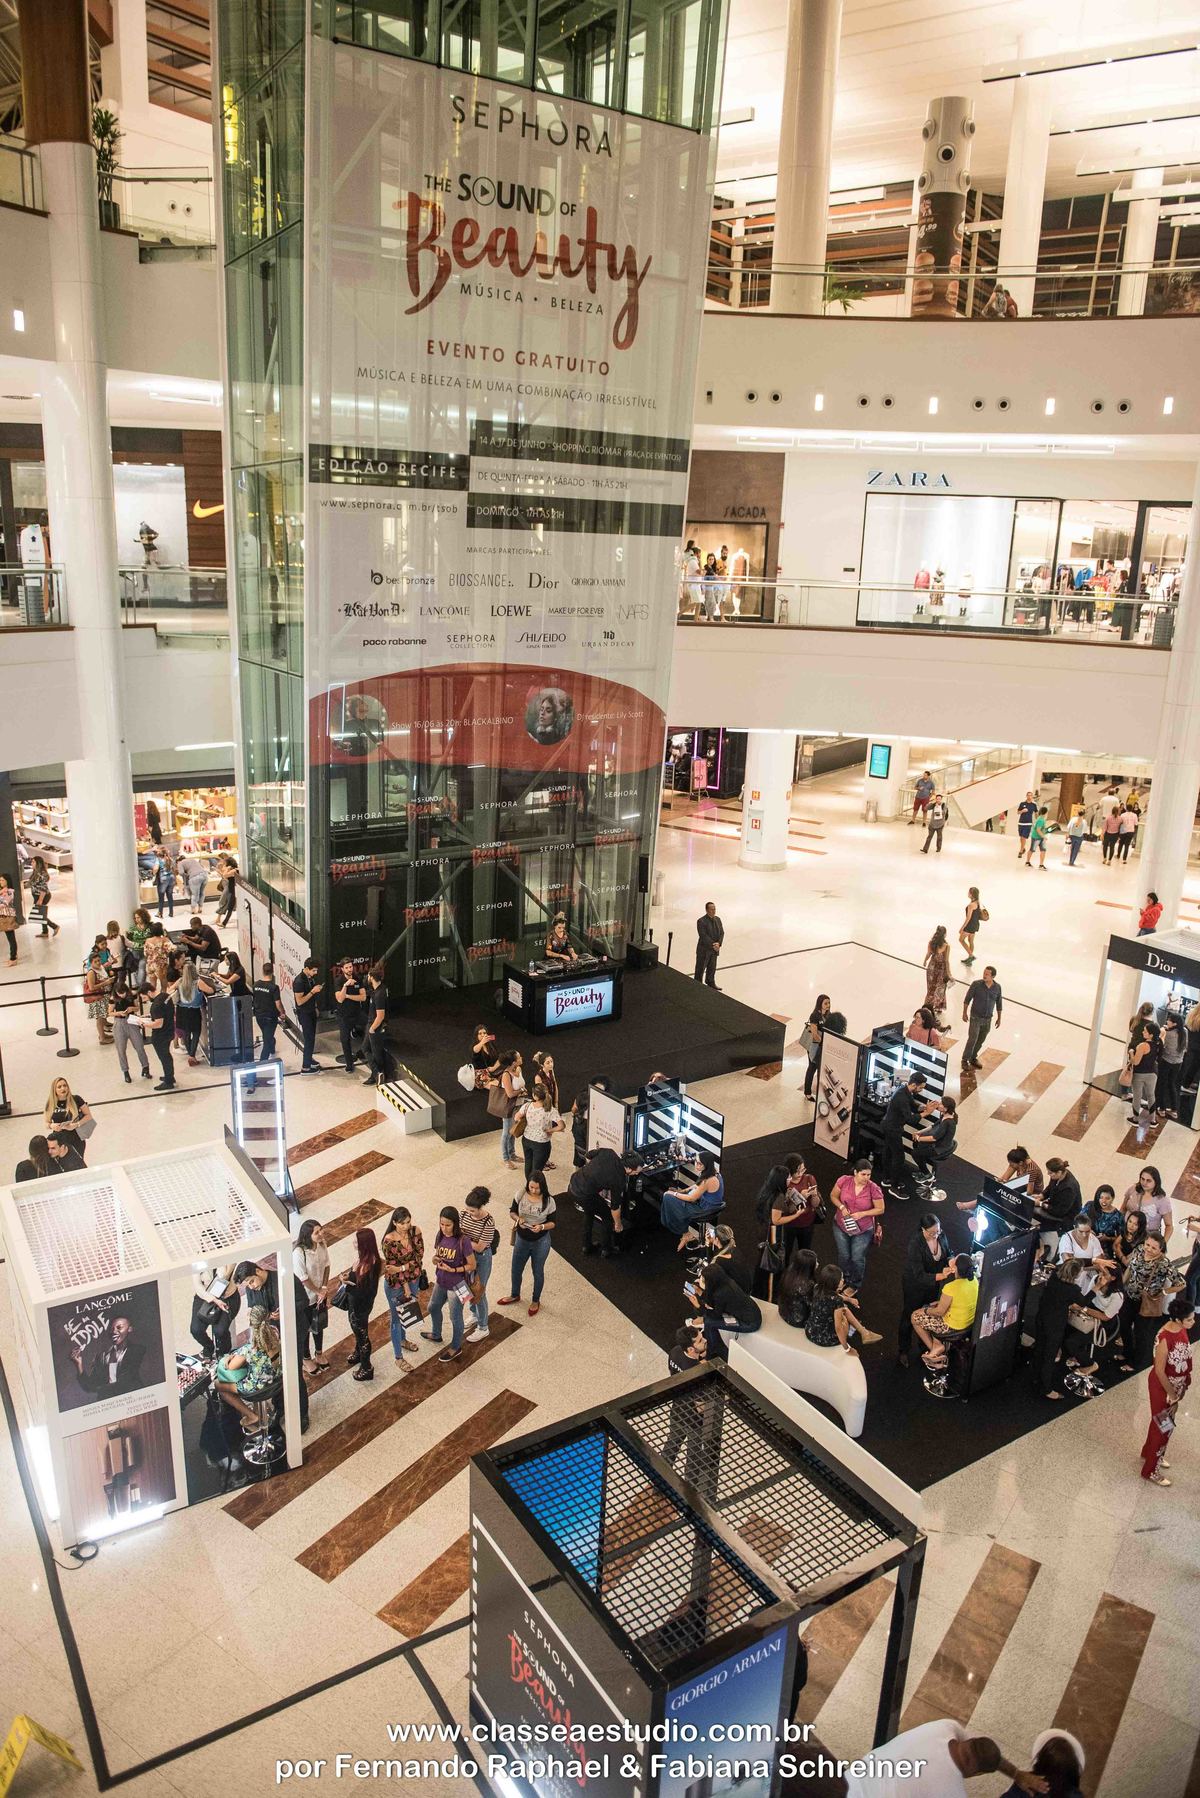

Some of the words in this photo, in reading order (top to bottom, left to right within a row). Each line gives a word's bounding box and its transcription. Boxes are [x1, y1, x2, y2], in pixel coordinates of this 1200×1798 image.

[451, 95, 614, 159] SEPHORA
[424, 174, 452, 194] THE
[559, 201, 577, 217] OF
[392, 190, 653, 351] Beauty
[460, 282, 524, 304] MÚSICA
[551, 296, 604, 316] BELEZA
[426, 338, 505, 364] EVENTO
[515, 350, 611, 377] GRATUITO
[357, 365, 406, 383] MÚSICA
[410, 371, 417, 384] E
[420, 373, 462, 389] BELEZA
[465, 376, 483, 391] EM
[486, 378, 513, 394] UMA
[517, 383, 593, 403] COMBINAÇÃO
[596, 393, 657, 410] IRRESISTÍVEL
[480, 436, 488, 445] 14
[490, 438, 496, 446] A
[507, 438, 517, 447] DE
[517, 439, 546, 450] JUNHO
[552, 442, 591, 455] SHOPPING
[592, 445, 622, 457] RIOMAR
[318, 457, 389, 475] EDIÇÃO
[399, 464, 456, 479] RECIFE
[478, 471, 488, 481] DE
[554, 475, 585, 487] SÁBADO
[866, 470, 952, 488] ZARA
[476, 506, 519, 517] DOMINGO
[723, 505, 767, 519] SACADA
[466, 546, 497, 554] MARCAS
[528, 572, 560, 589] Dior
[571, 576, 600, 587] GIORGIO
[601, 578, 625, 587] ARMANI
[490, 605, 533, 617] LOEWE
[548, 607, 567, 615] MAKE
[567, 607, 576, 615] UP
[362, 638, 387, 647] paco
[388, 637, 427, 646] rabanne
[446, 634, 496, 643] SEPHORA
[515, 631, 567, 643] SHISEIDO
[391, 721, 411, 730] Show
[414, 719, 434, 729] 16/06
[463, 716, 514, 727] BLACKALBINO
[604, 790, 638, 799] SEPHORA
[480, 800, 518, 810] SEPHORA
[340, 811, 383, 822] SEPHORA
[752, 819, 760, 829] H
[540, 843, 575, 853] SEPHORA
[410, 857, 450, 868] SEPHORA
[597, 884, 630, 894] SEPHORA
[476, 901, 513, 911] SEPHORA
[408, 956, 447, 967] SEPHORA
[1145, 951, 1177, 974] Dior
[554, 988, 605, 1018] Beauty
[995, 1188, 1022, 1205] SHISEIDO
[63, 1318, 82, 1336] BE
[524, 1610, 576, 1688] SEPHORA
[671, 1669, 728, 1711] GIORGIO
[732, 1638, 781, 1678] ARMANI
